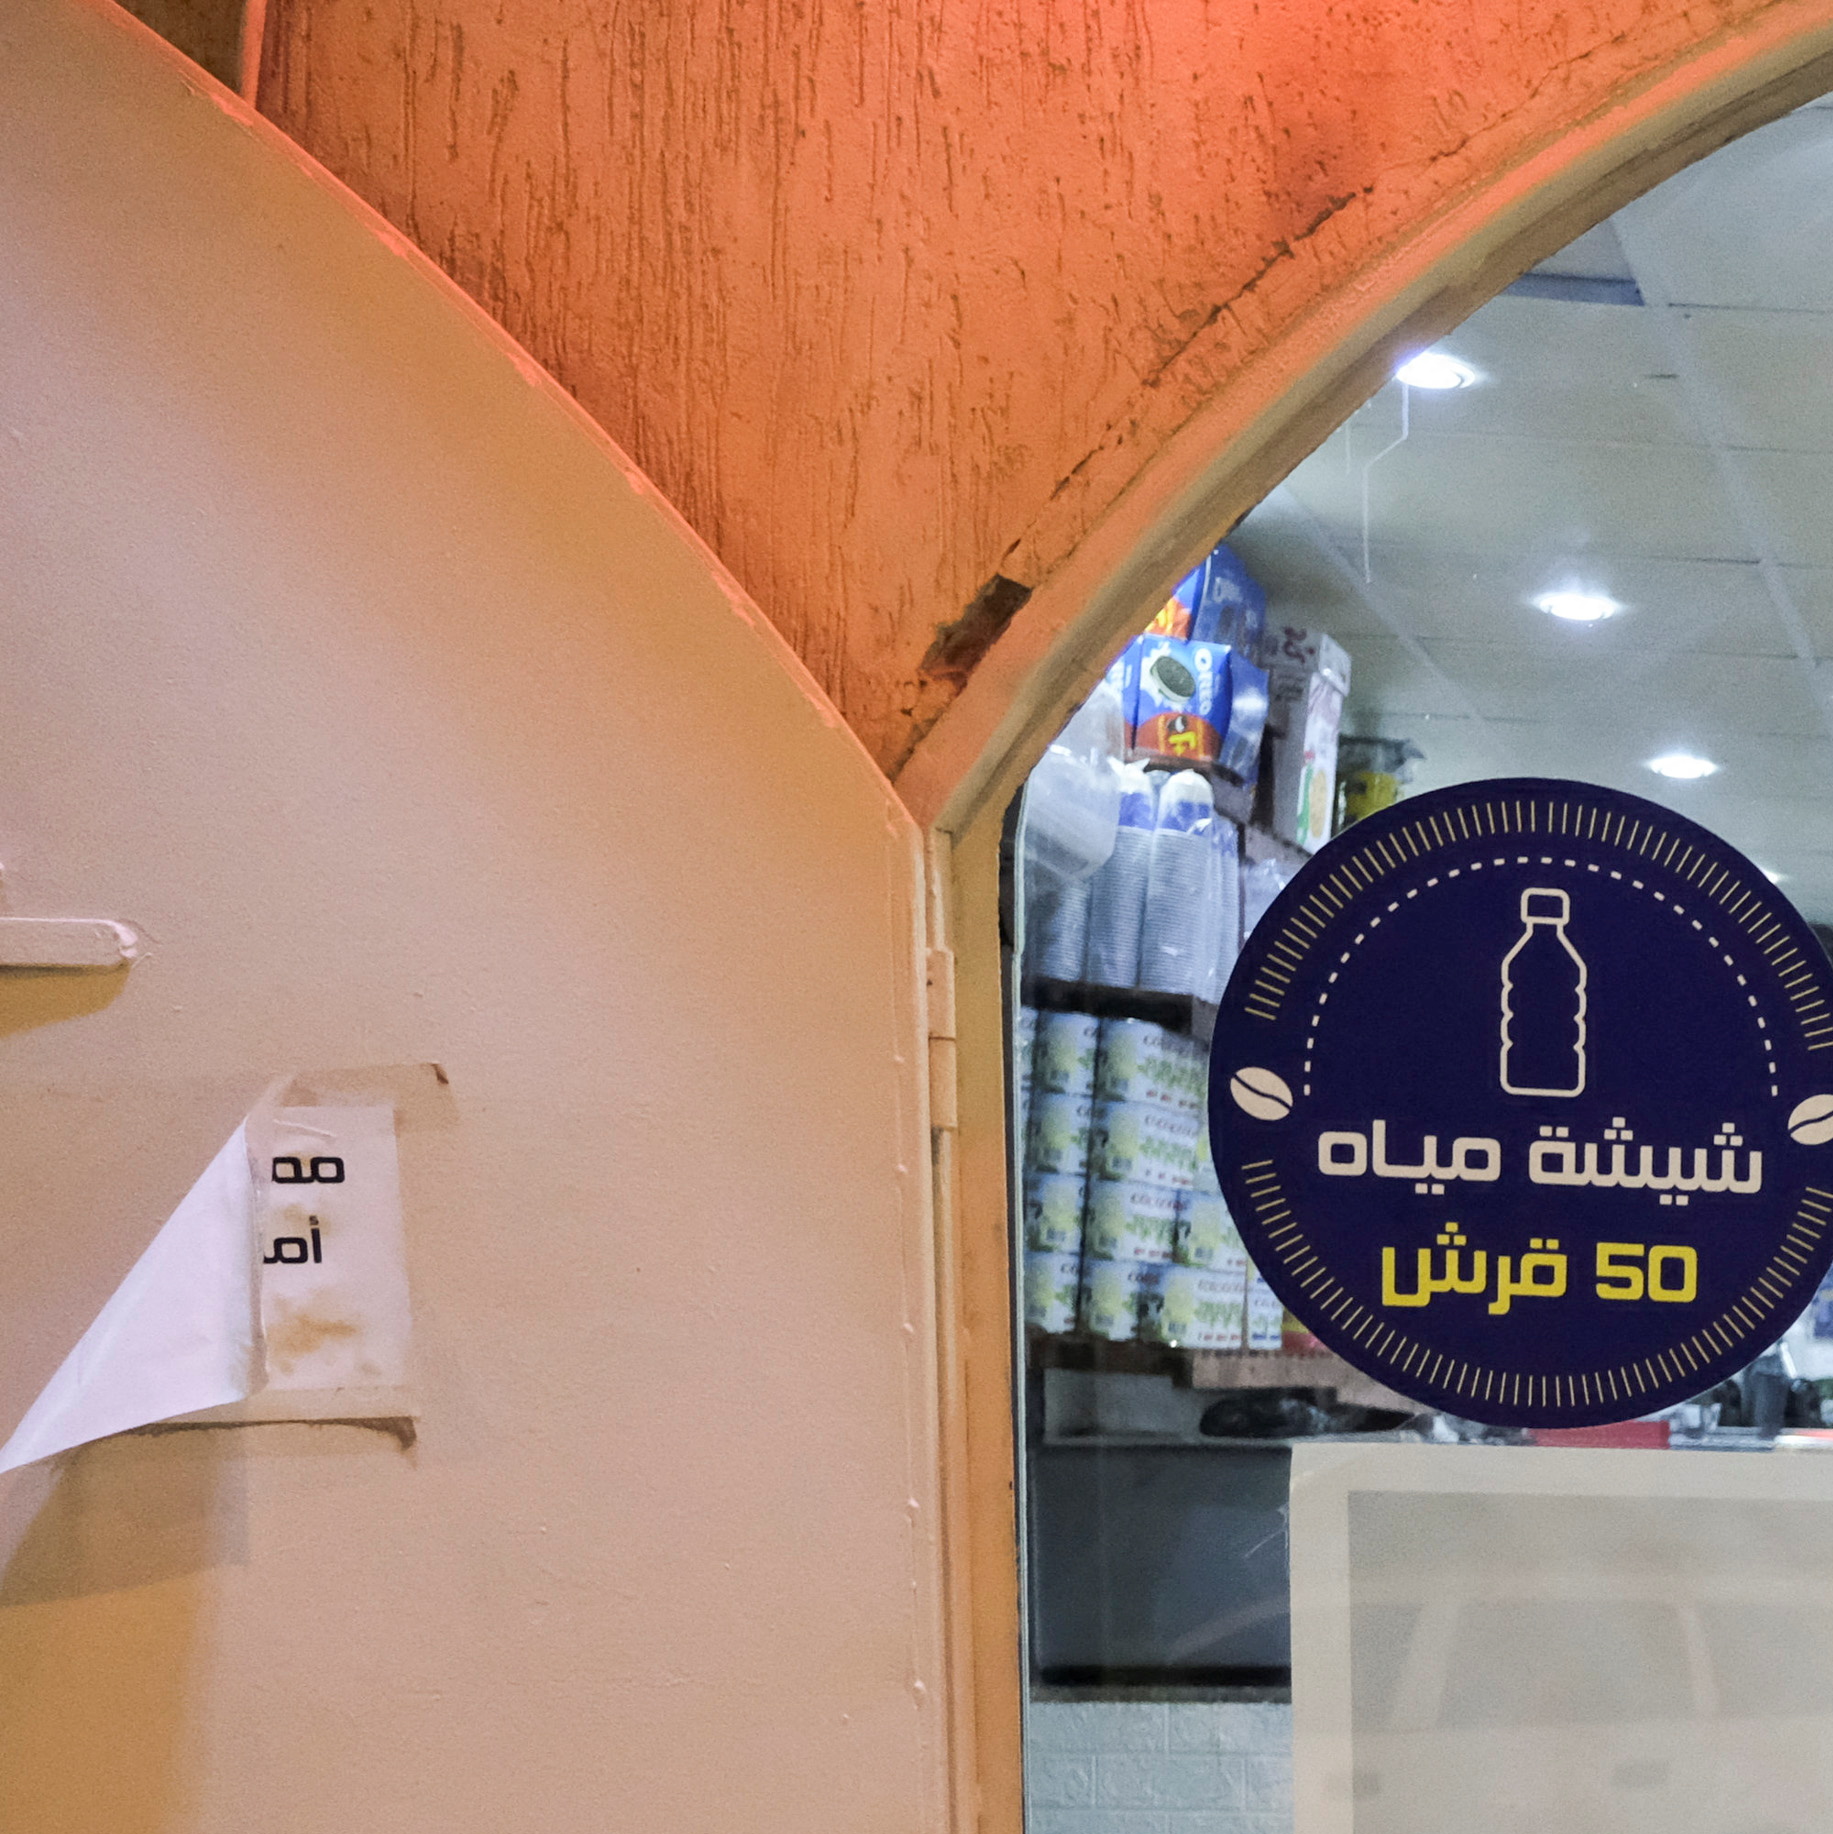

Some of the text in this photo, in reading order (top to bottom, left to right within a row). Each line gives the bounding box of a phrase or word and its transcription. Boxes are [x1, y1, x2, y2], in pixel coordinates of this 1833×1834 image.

[1317, 1115, 1763, 1206] شيشة مياه
[1381, 1221, 1698, 1315] 50 قرش
